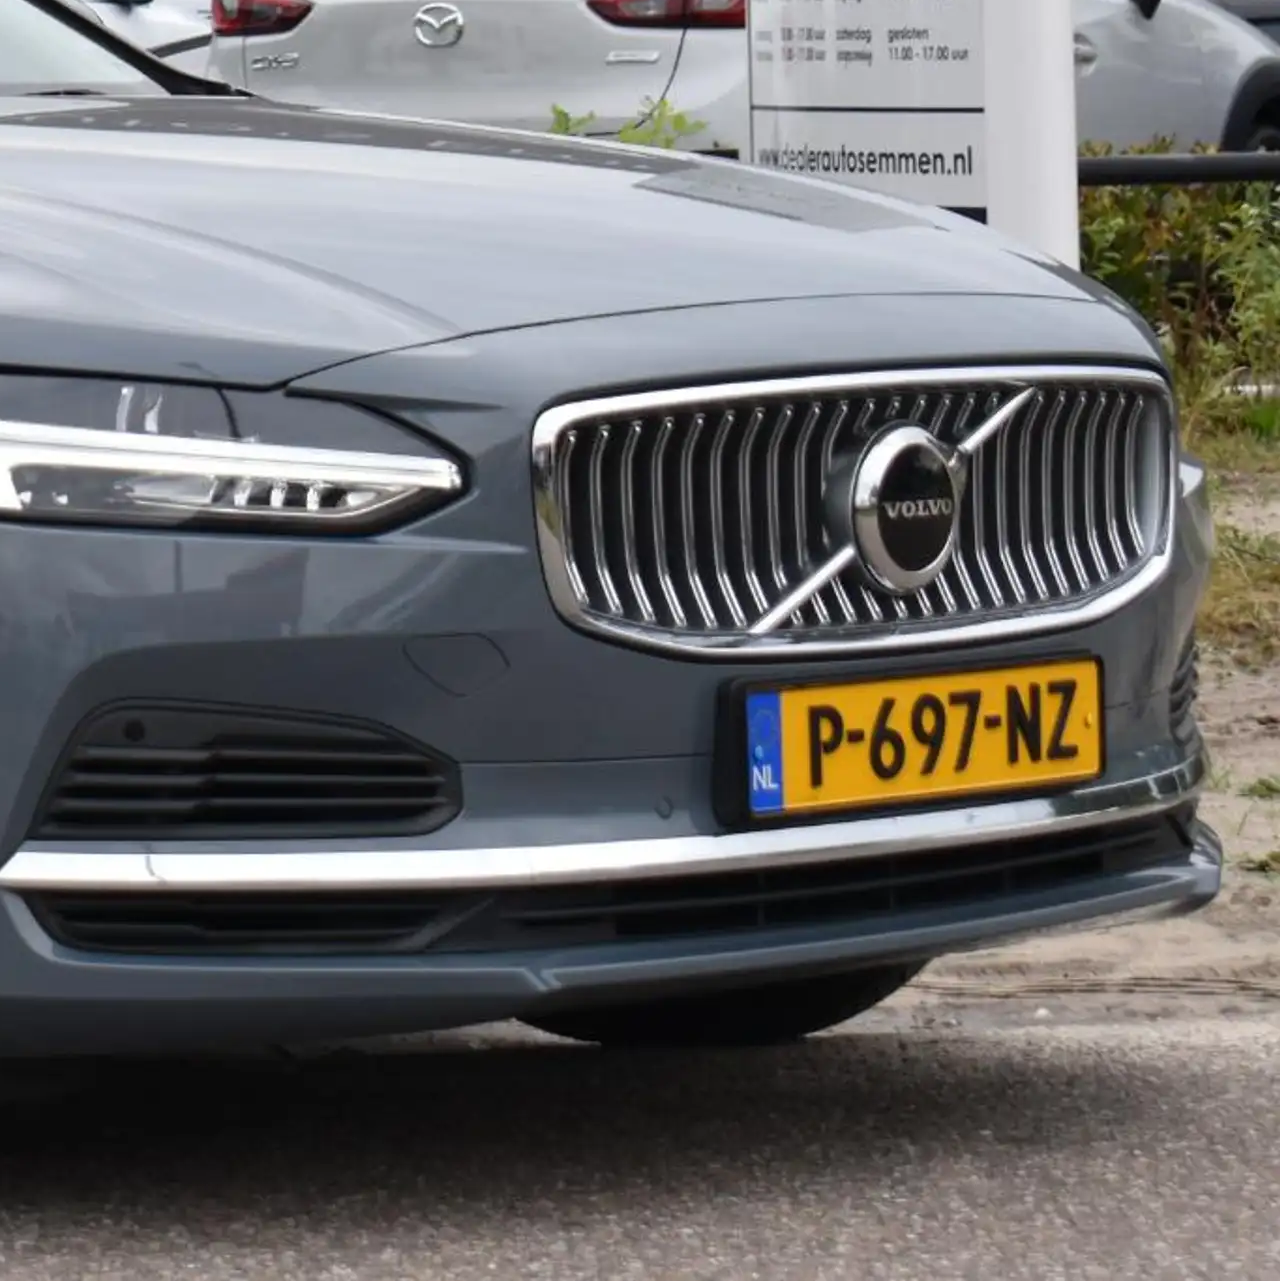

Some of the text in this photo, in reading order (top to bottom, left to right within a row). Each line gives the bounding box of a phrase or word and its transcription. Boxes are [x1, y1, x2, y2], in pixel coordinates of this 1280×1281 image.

[883, 499, 953, 519] VOLVO
[807, 679, 1080, 789] P-697-NZ
[752, 763, 778, 791] NL
